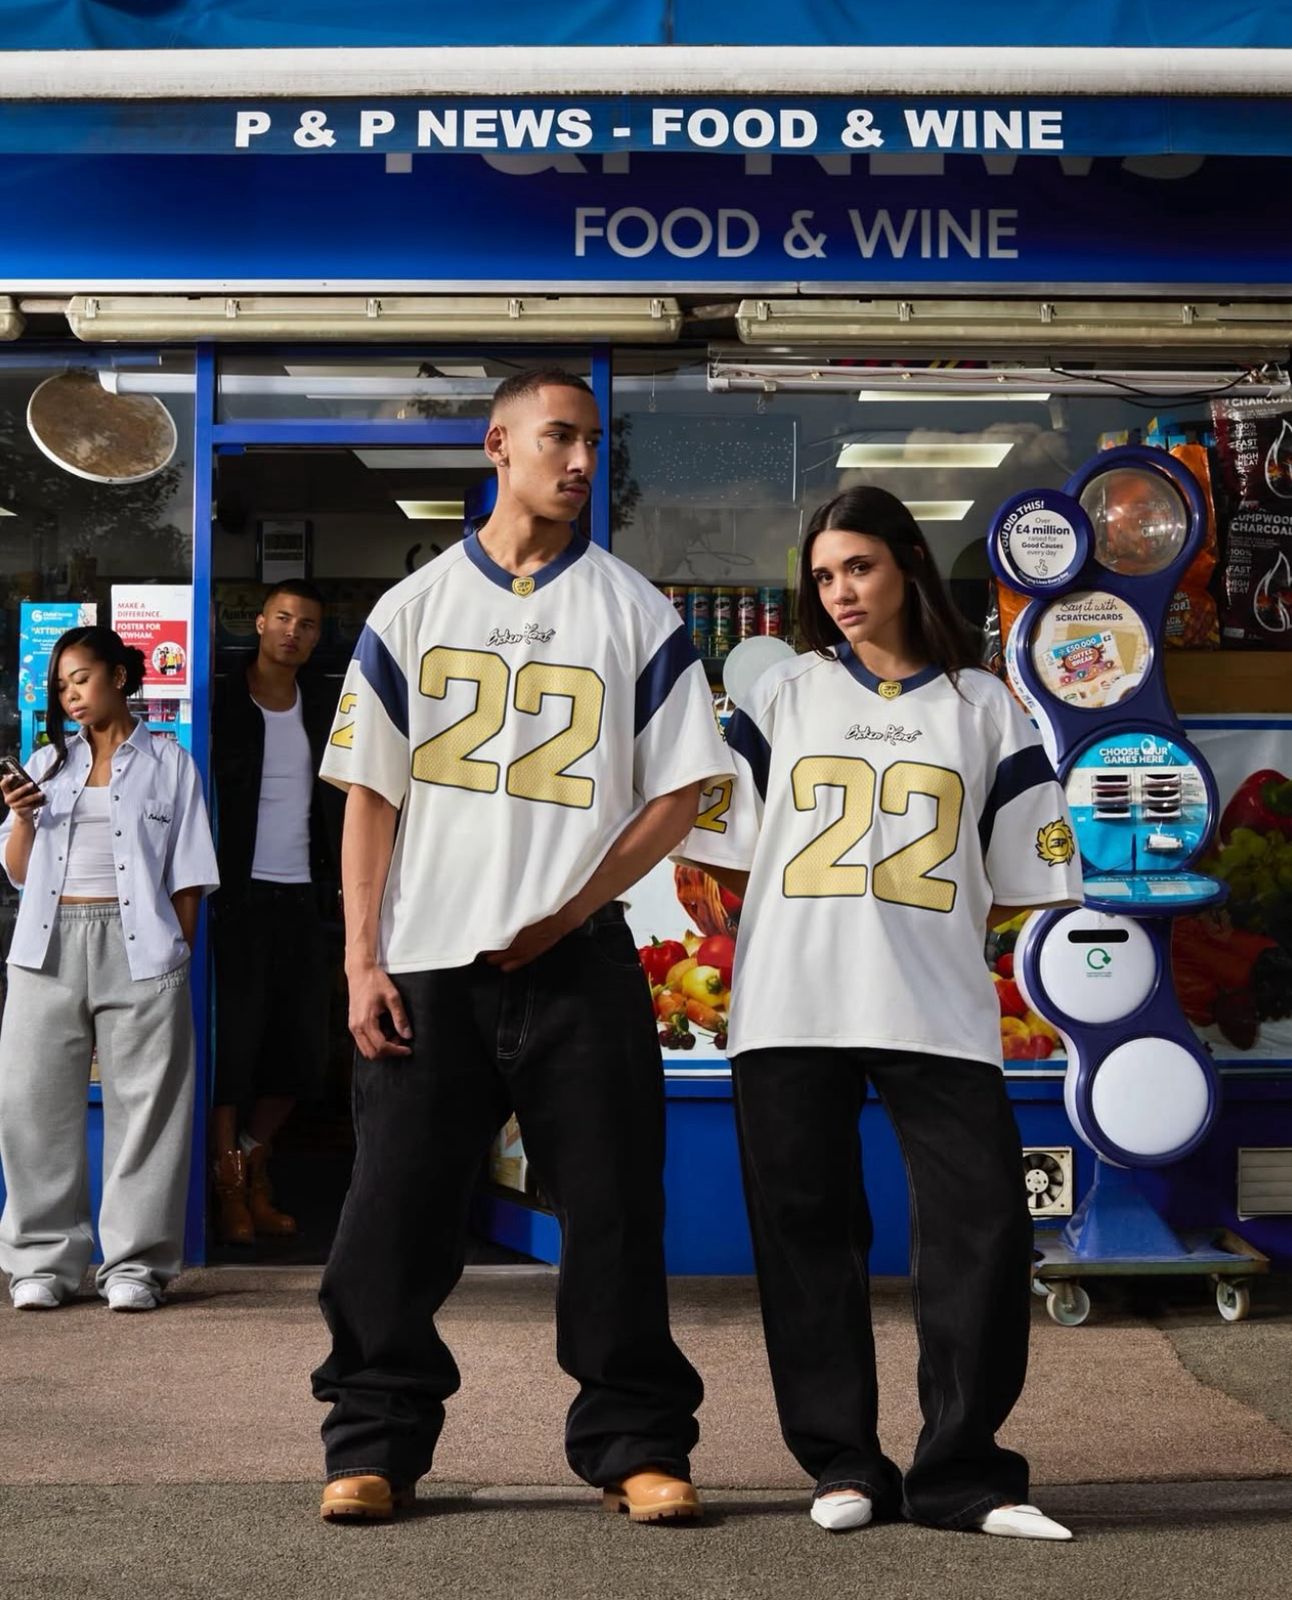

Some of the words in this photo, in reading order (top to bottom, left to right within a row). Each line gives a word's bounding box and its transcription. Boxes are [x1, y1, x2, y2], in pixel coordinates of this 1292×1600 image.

[236, 111, 270, 148] P
[293, 110, 337, 148] &
[359, 110, 395, 147] P
[417, 108, 593, 148] NEWS
[652, 108, 818, 148] FOOD
[841, 109, 884, 148] &
[904, 110, 1064, 149] WINE
[574, 207, 760, 258] FOOD
[783, 210, 827, 258] &
[849, 208, 1019, 260] WINE
[1238, 452, 1259, 460] HIGH
[1016, 500, 1045, 515] THIS!
[1003, 513, 1018, 532] DID
[1016, 524, 1030, 535] £4
[1032, 524, 1071, 536] million
[1001, 532, 1010, 553] YOU
[1021, 541, 1039, 549] Good
[1040, 542, 1064, 550] Causes
[1060, 601, 1082, 613] Say
[1084, 599, 1093, 611] it
[1095, 598, 1118, 611] with
[1056, 613, 1123, 621] SCRATCHCARDS
[117, 623, 144, 631] FOSTER
[146, 623, 161, 631] FOR
[412, 645, 606, 810] 22
[1099, 747, 1140, 756] CHOOSE
[1104, 755, 1137, 764] GAMES
[1139, 755, 1164, 764] HERE
[782, 754, 965, 914] 22
